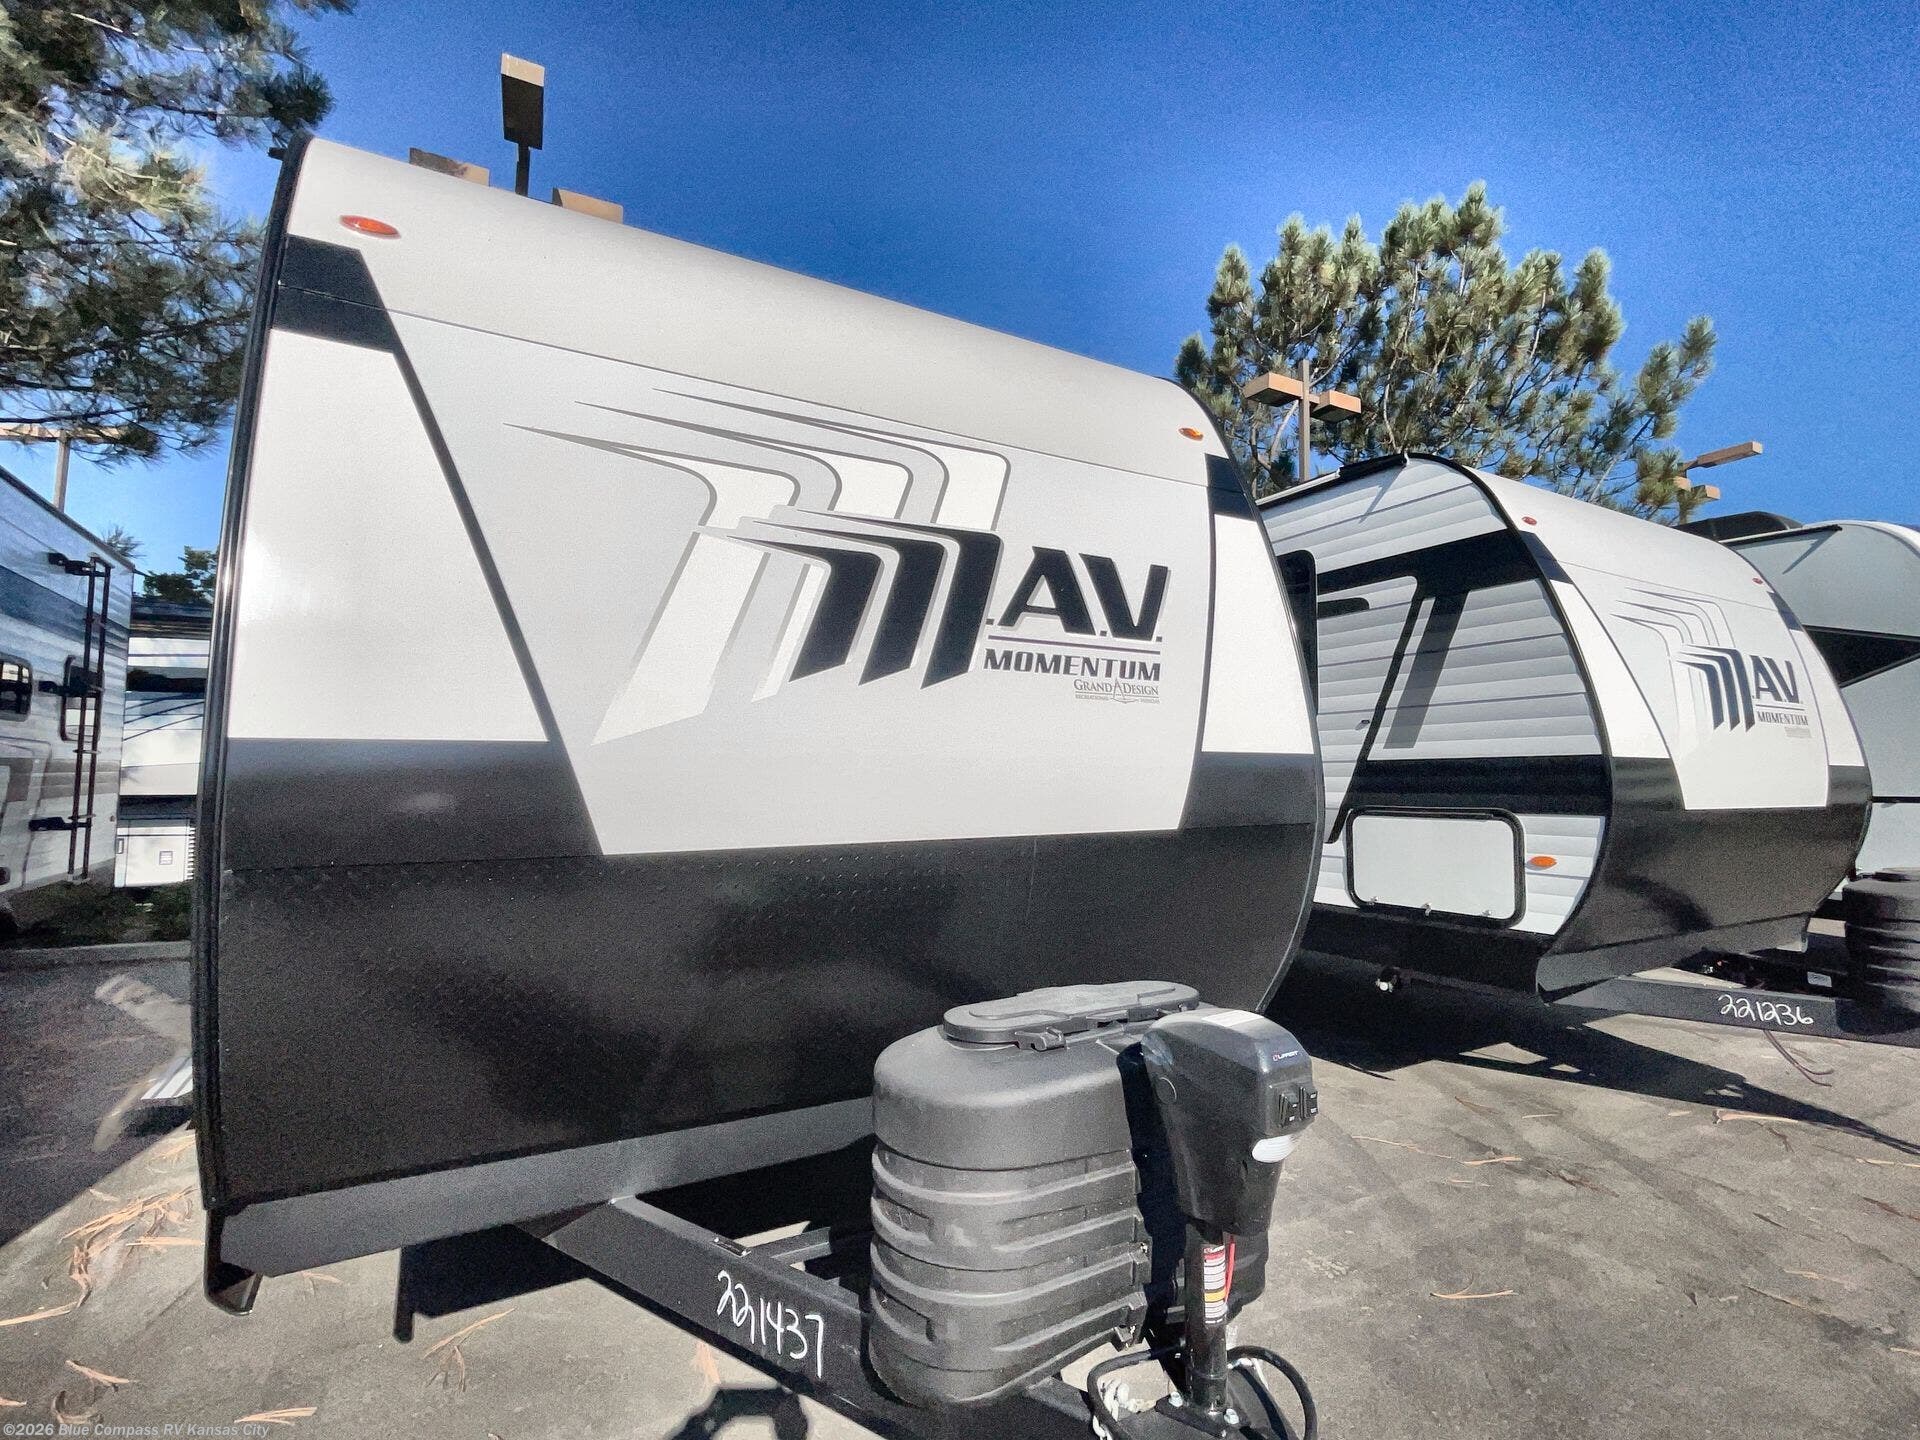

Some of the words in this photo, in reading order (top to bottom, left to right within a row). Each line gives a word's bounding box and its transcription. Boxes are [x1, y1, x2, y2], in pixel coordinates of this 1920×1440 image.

[983, 649, 1161, 682] MOMENTUM
[1073, 679, 1113, 693] GRAND
[1122, 682, 1159, 695] DESIGN
[1757, 711, 1809, 726] MOMENTUM
[1718, 994, 1815, 1026] 221236
[716, 1270, 824, 1379] 221437
